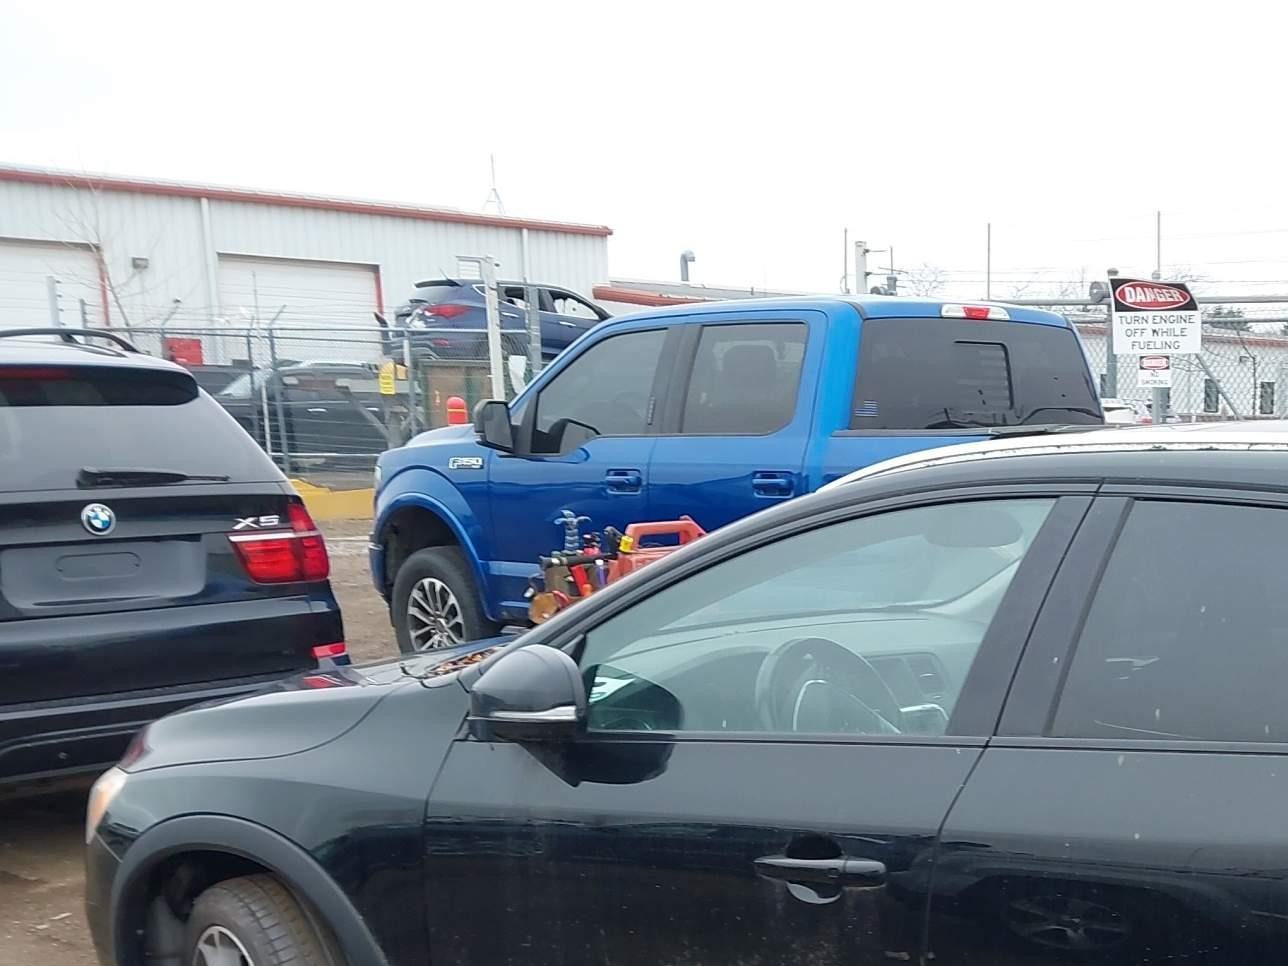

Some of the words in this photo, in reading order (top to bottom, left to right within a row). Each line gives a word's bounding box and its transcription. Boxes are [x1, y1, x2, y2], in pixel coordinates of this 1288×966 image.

[1123, 286, 1184, 302] DANGER
[1119, 315, 1149, 325] TURN
[1152, 315, 1196, 324] ENGINE
[1125, 328, 1147, 337] OFF
[1152, 327, 1187, 337] WHILE
[1131, 340, 1181, 349] FUELING
[231, 514, 280, 529] X5
